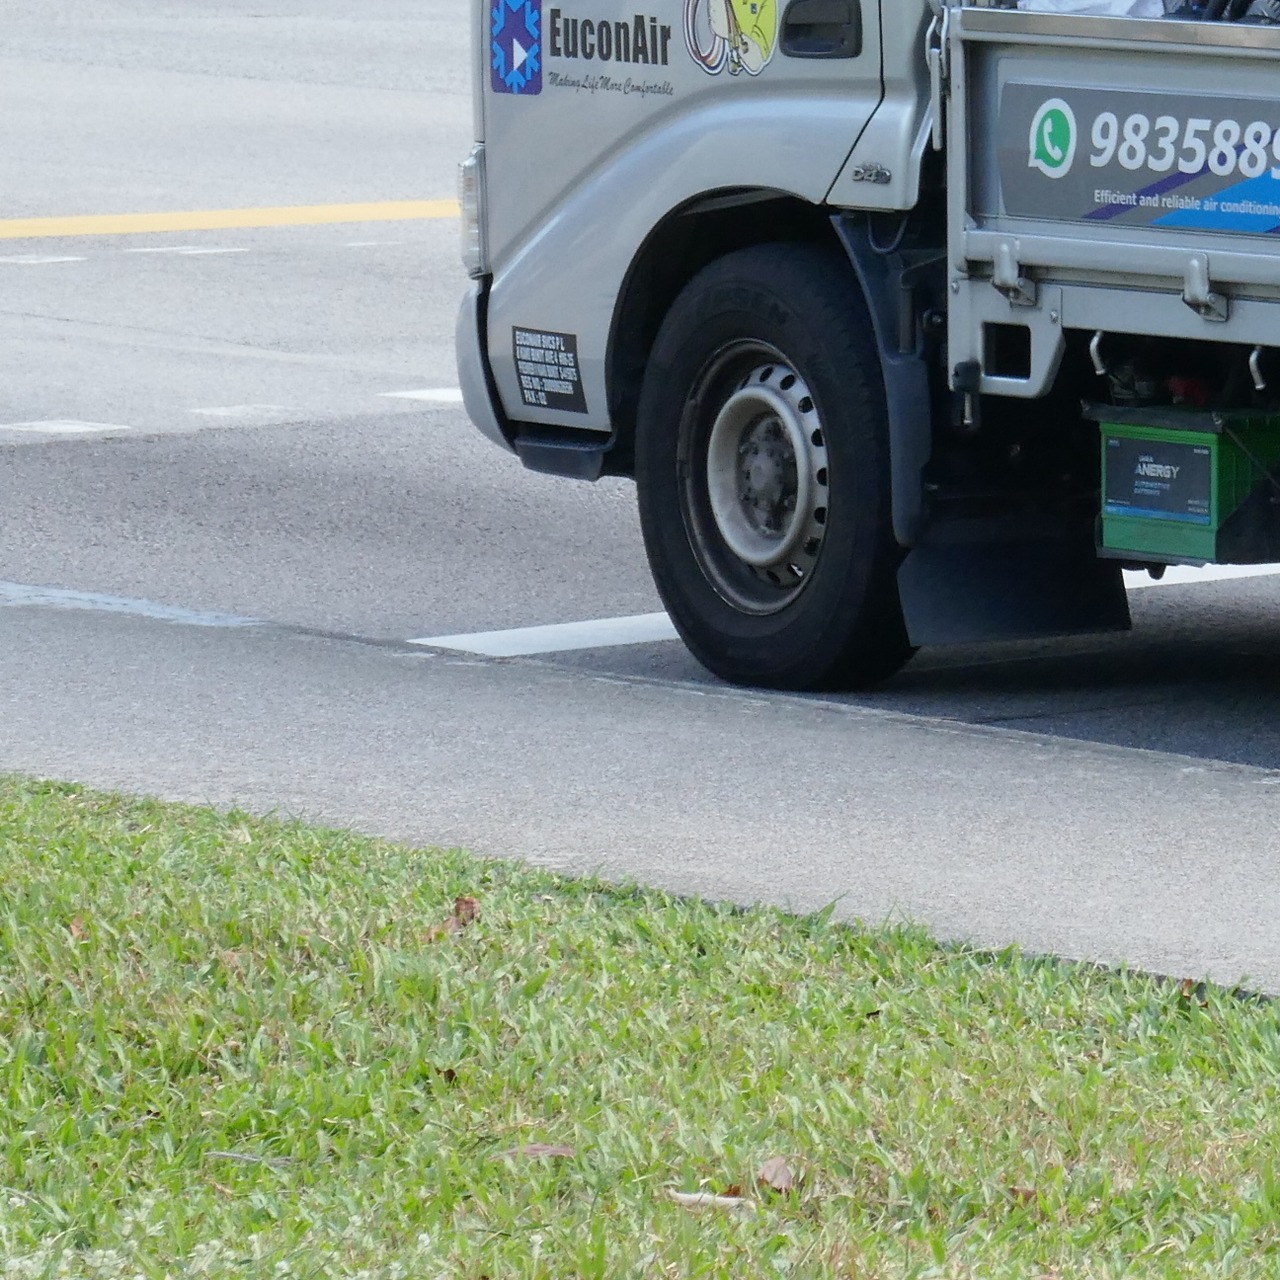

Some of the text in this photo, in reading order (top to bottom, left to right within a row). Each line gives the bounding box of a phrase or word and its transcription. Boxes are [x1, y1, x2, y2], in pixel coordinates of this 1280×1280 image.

[550, 8, 671, 66] EuconAir
[548, 71, 674, 98] Making Life More Comfortable
[1094, 189, 1137, 206] Efficient
[1139, 194, 1159, 208] and
[1161, 195, 1200, 210] reliable
[1203, 197, 1219, 212] air
[1134, 463, 1180, 479] ANERGY
